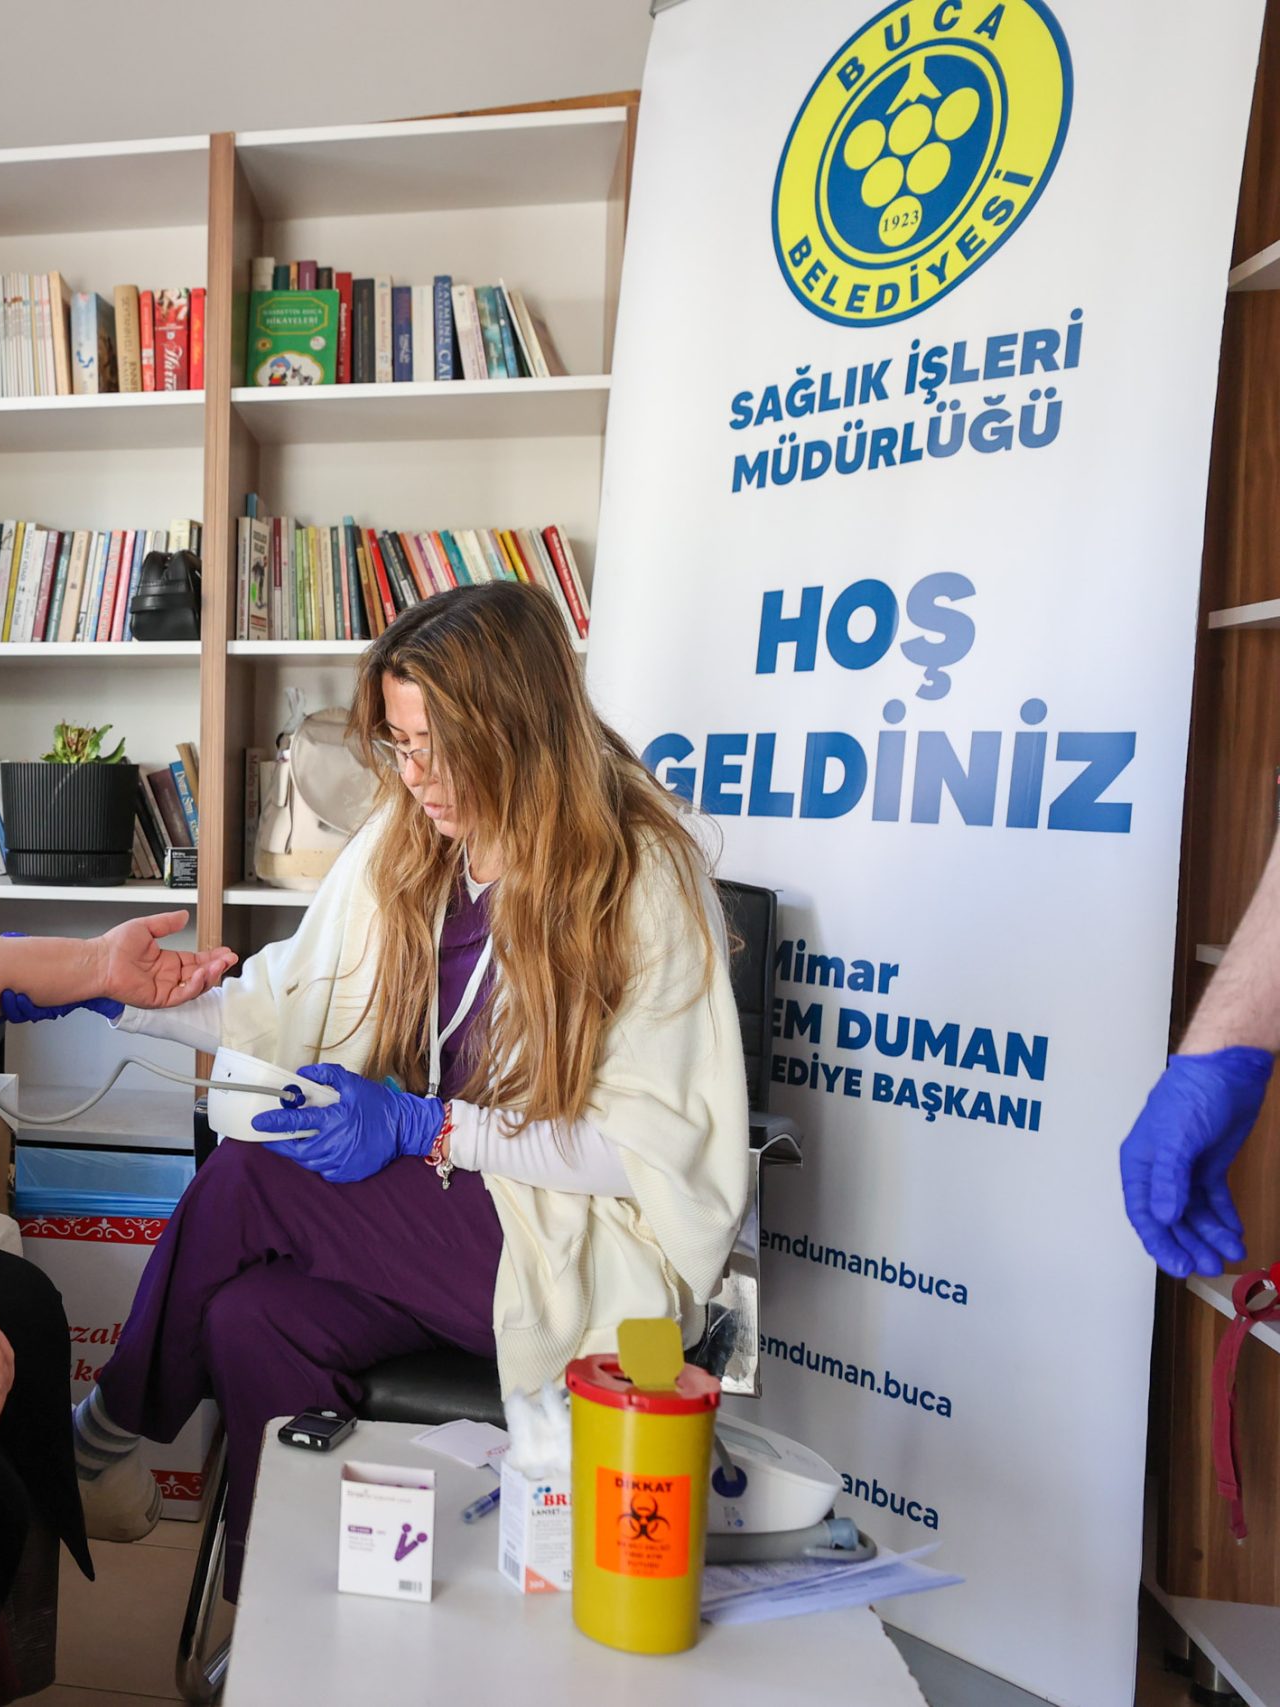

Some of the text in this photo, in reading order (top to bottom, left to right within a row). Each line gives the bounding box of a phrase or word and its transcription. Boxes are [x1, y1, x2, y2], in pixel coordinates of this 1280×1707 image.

[836, 0, 1006, 92] BUCA
[788, 169, 1034, 314] BELEDİYESİ
[881, 209, 920, 233] 1923
[729, 307, 1084, 430] SAĞLIK İŞLERİ
[731, 386, 1063, 493] MÜDÜRLÜĞÜ
[755, 571, 977, 701] HOŞ
[638, 698, 1137, 834] GELDİNİZ
[836, 1007, 1049, 1082] DUMAN
[771, 1052, 1042, 1133] EDİYE BAŞKANI
[760, 1228, 969, 1306] emdumanbbuca
[841, 1472, 939, 1530] anbuca
